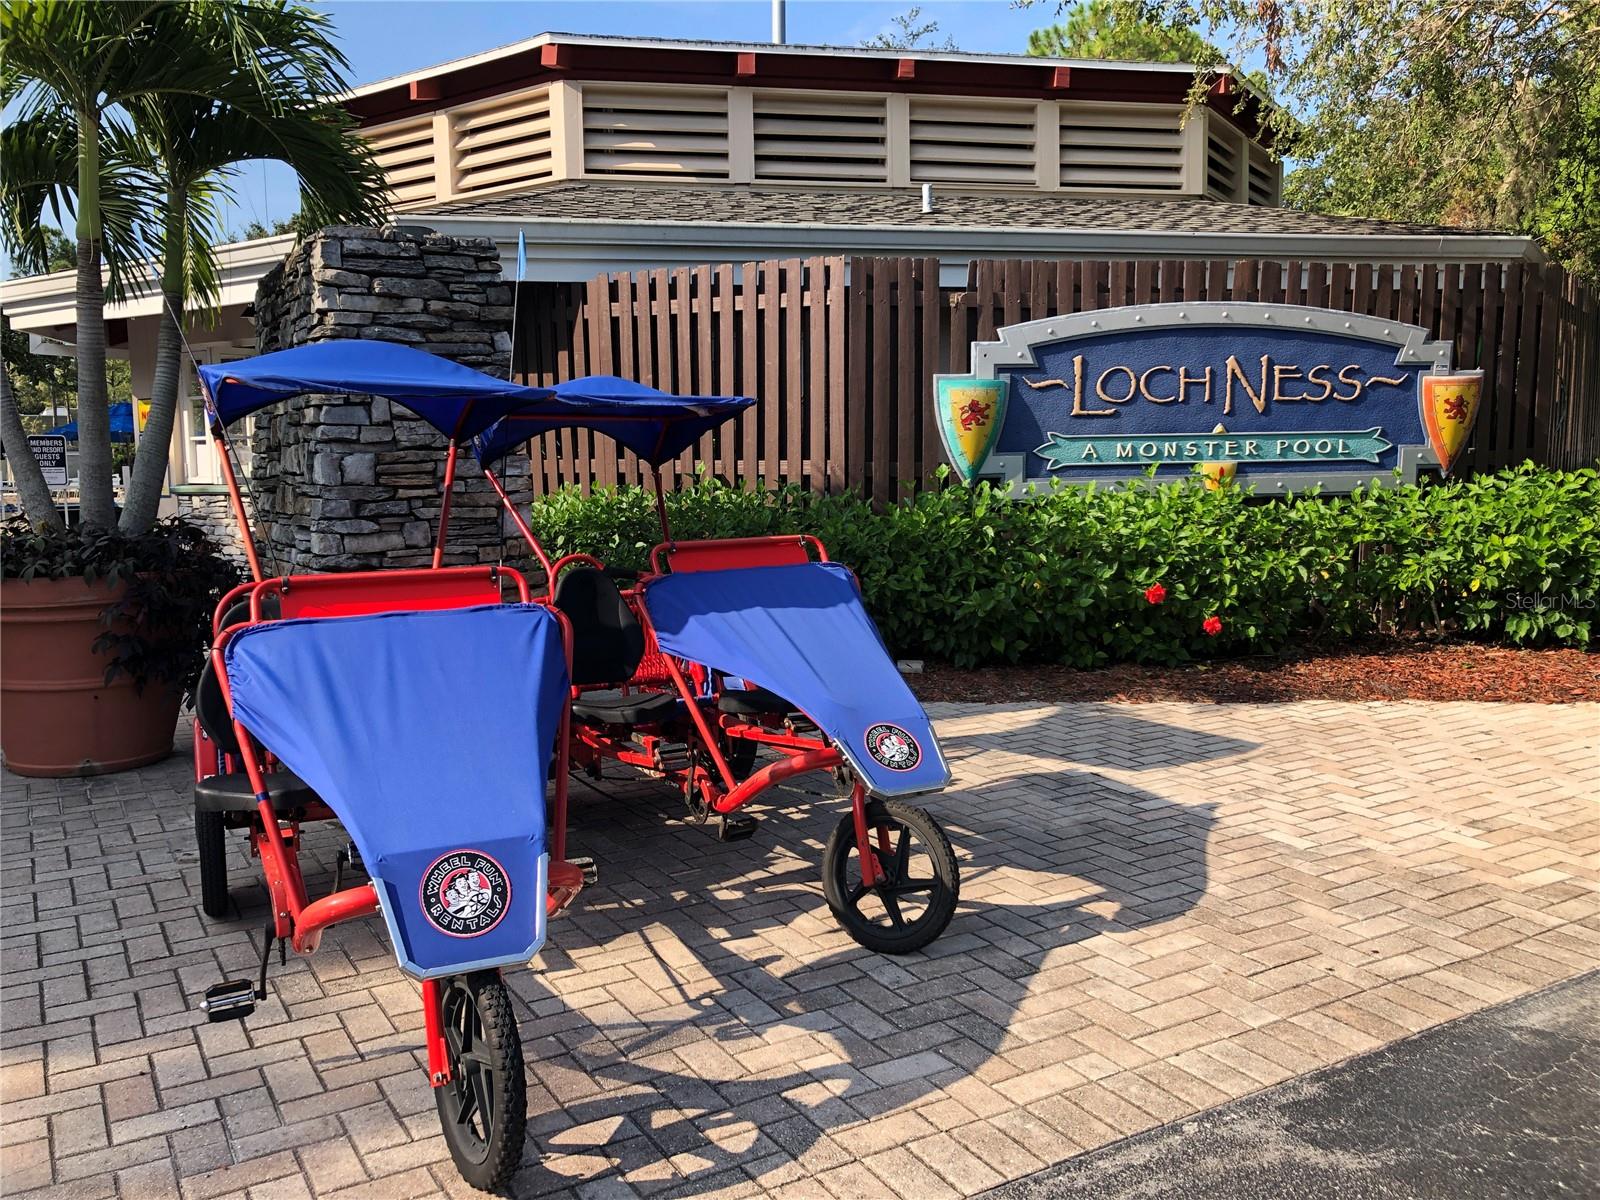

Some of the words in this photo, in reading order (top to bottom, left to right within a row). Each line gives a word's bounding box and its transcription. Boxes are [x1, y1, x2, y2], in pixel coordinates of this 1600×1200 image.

[1070, 354, 1212, 416] LOCH
[1222, 353, 1362, 415] NESS
[30, 439, 63, 447] MEMBERS
[1081, 442, 1098, 459] A
[1116, 438, 1258, 459] MONSTER
[1276, 437, 1352, 456] POOL
[426, 856, 471, 896] WHEEL
[474, 858, 502, 886] FUN
[430, 894, 503, 931] RENTALS
